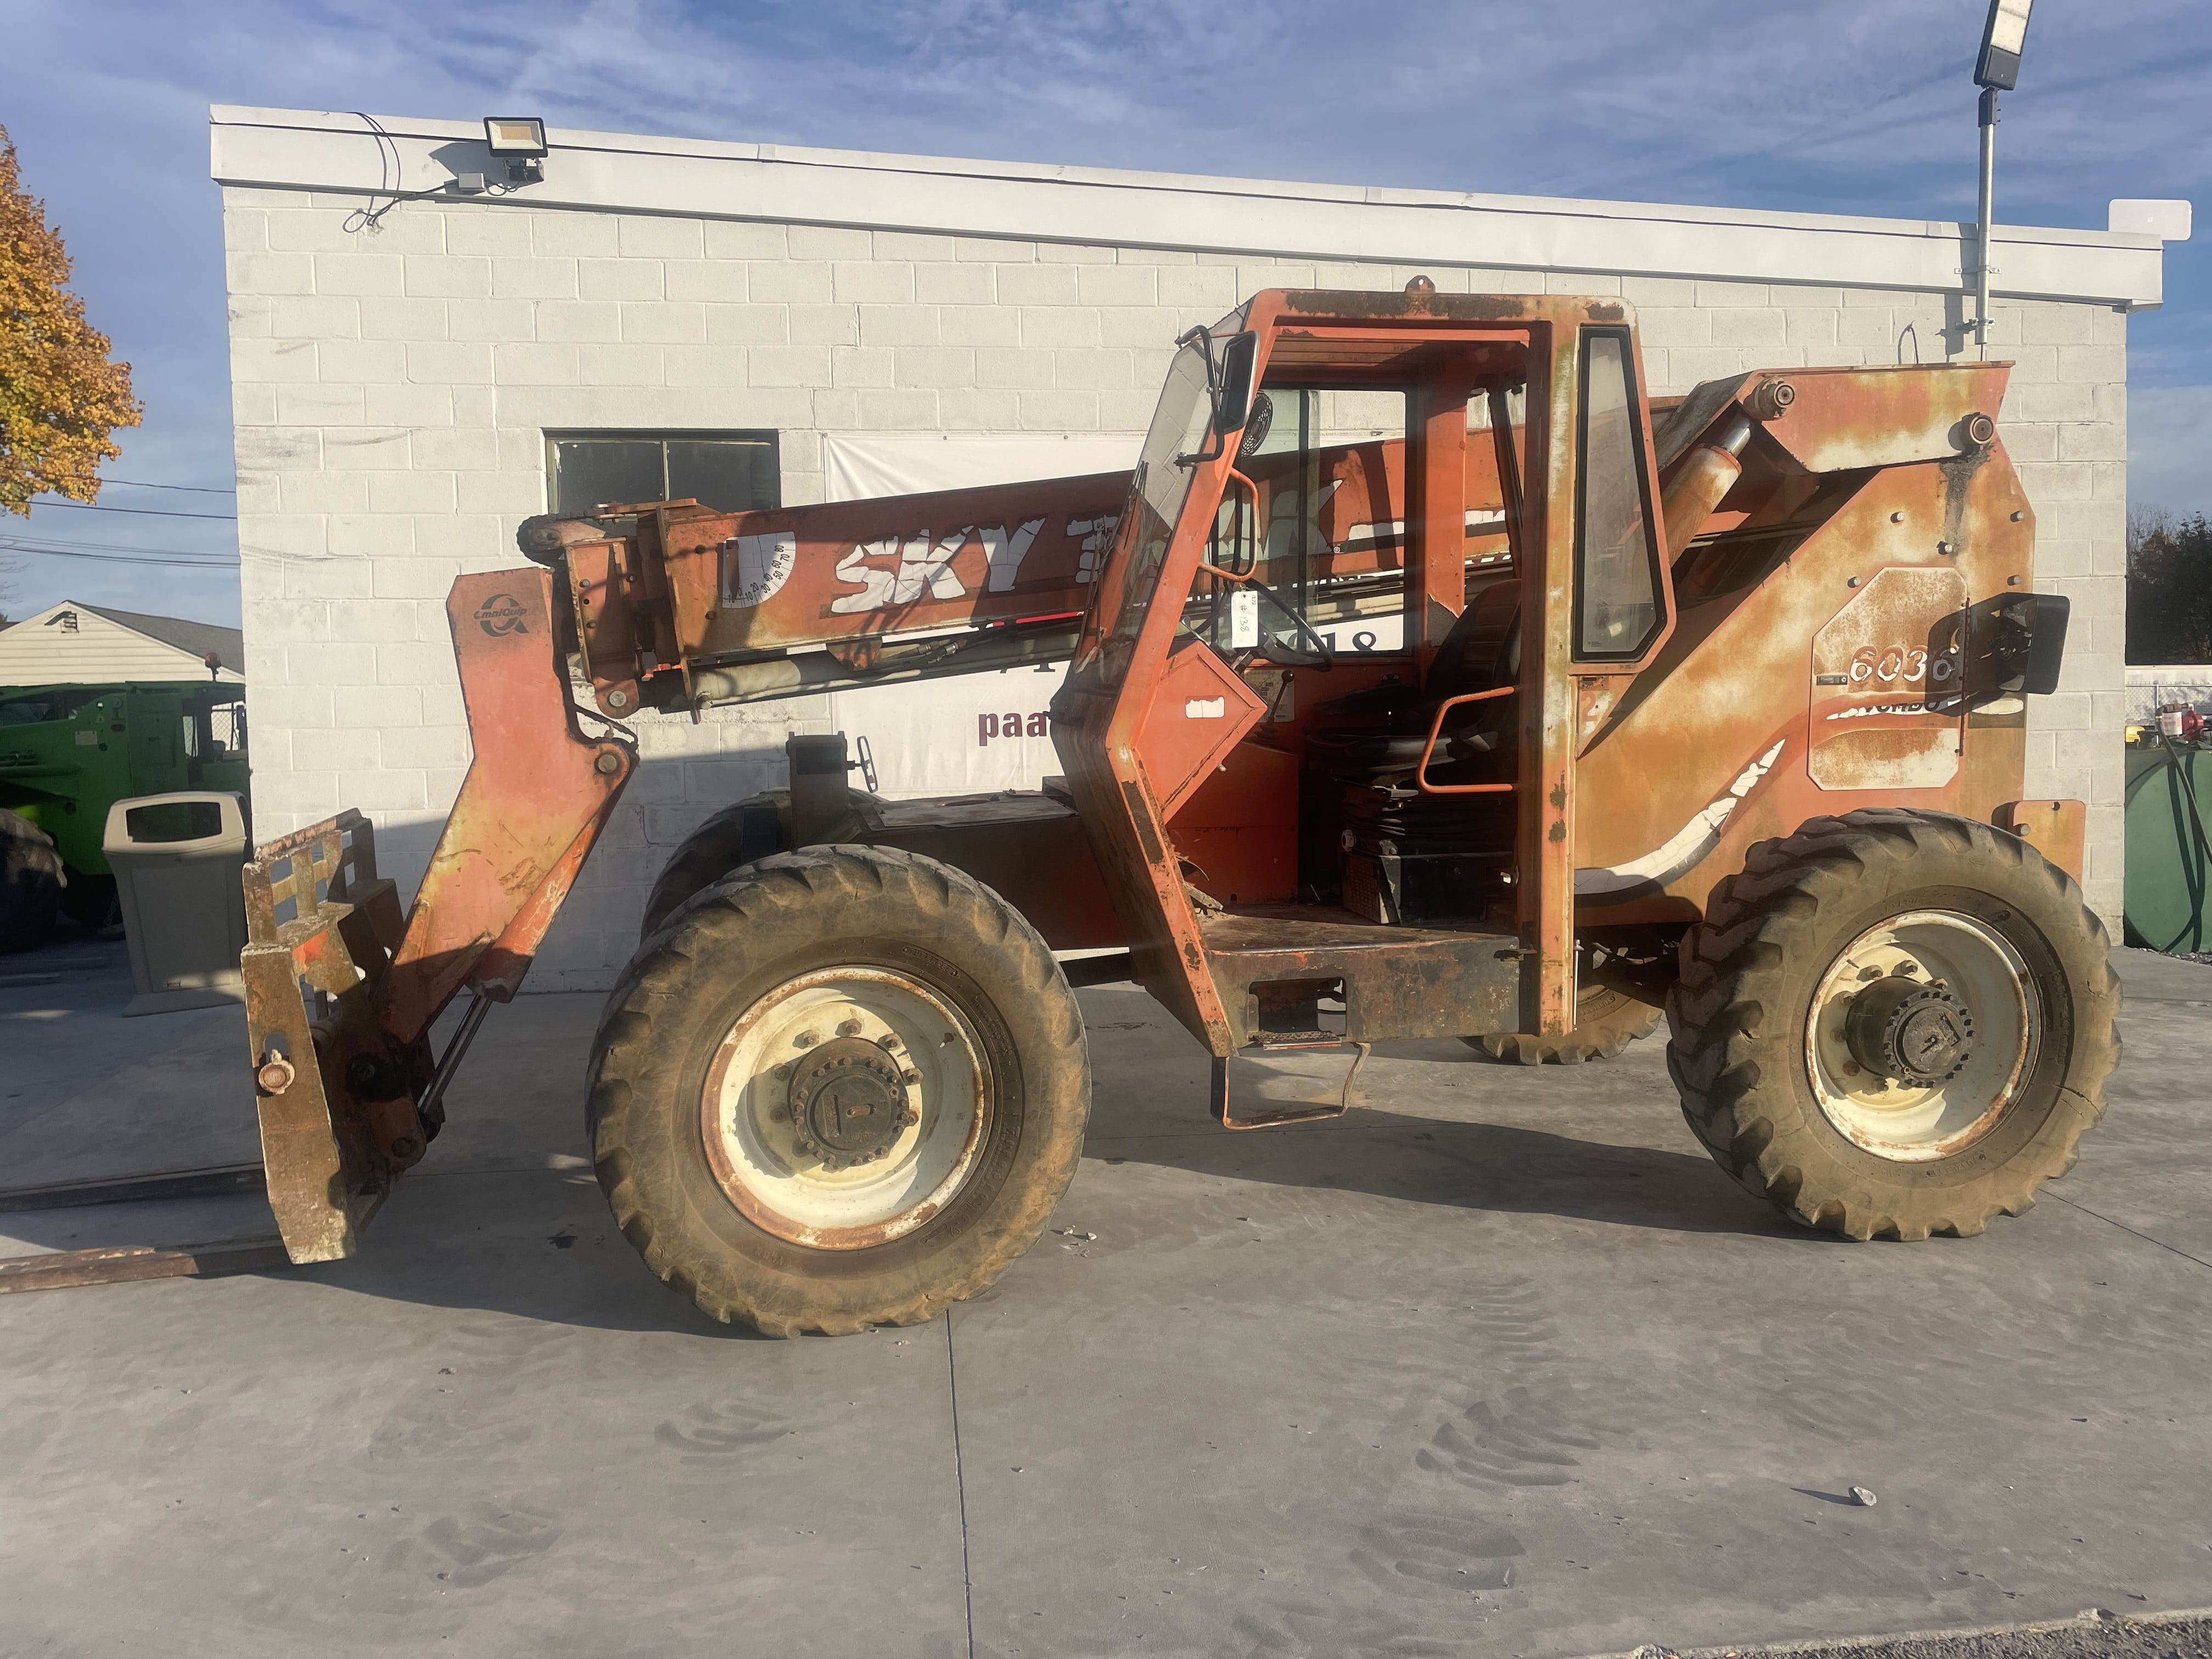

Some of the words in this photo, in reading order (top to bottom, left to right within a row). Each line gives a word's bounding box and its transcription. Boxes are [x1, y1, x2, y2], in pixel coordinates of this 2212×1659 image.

[780, 554, 790, 562] 70
[771, 560, 781, 568] 60
[831, 517, 1046, 613] SKY
[764, 573, 773, 582] 40
[773, 571, 783, 580] 50
[751, 582, 759, 592] 20
[761, 583, 771, 593] 30
[745, 591, 753, 601] 10
[1849, 645, 1959, 682] 6036
[978, 712, 1047, 747] paa
